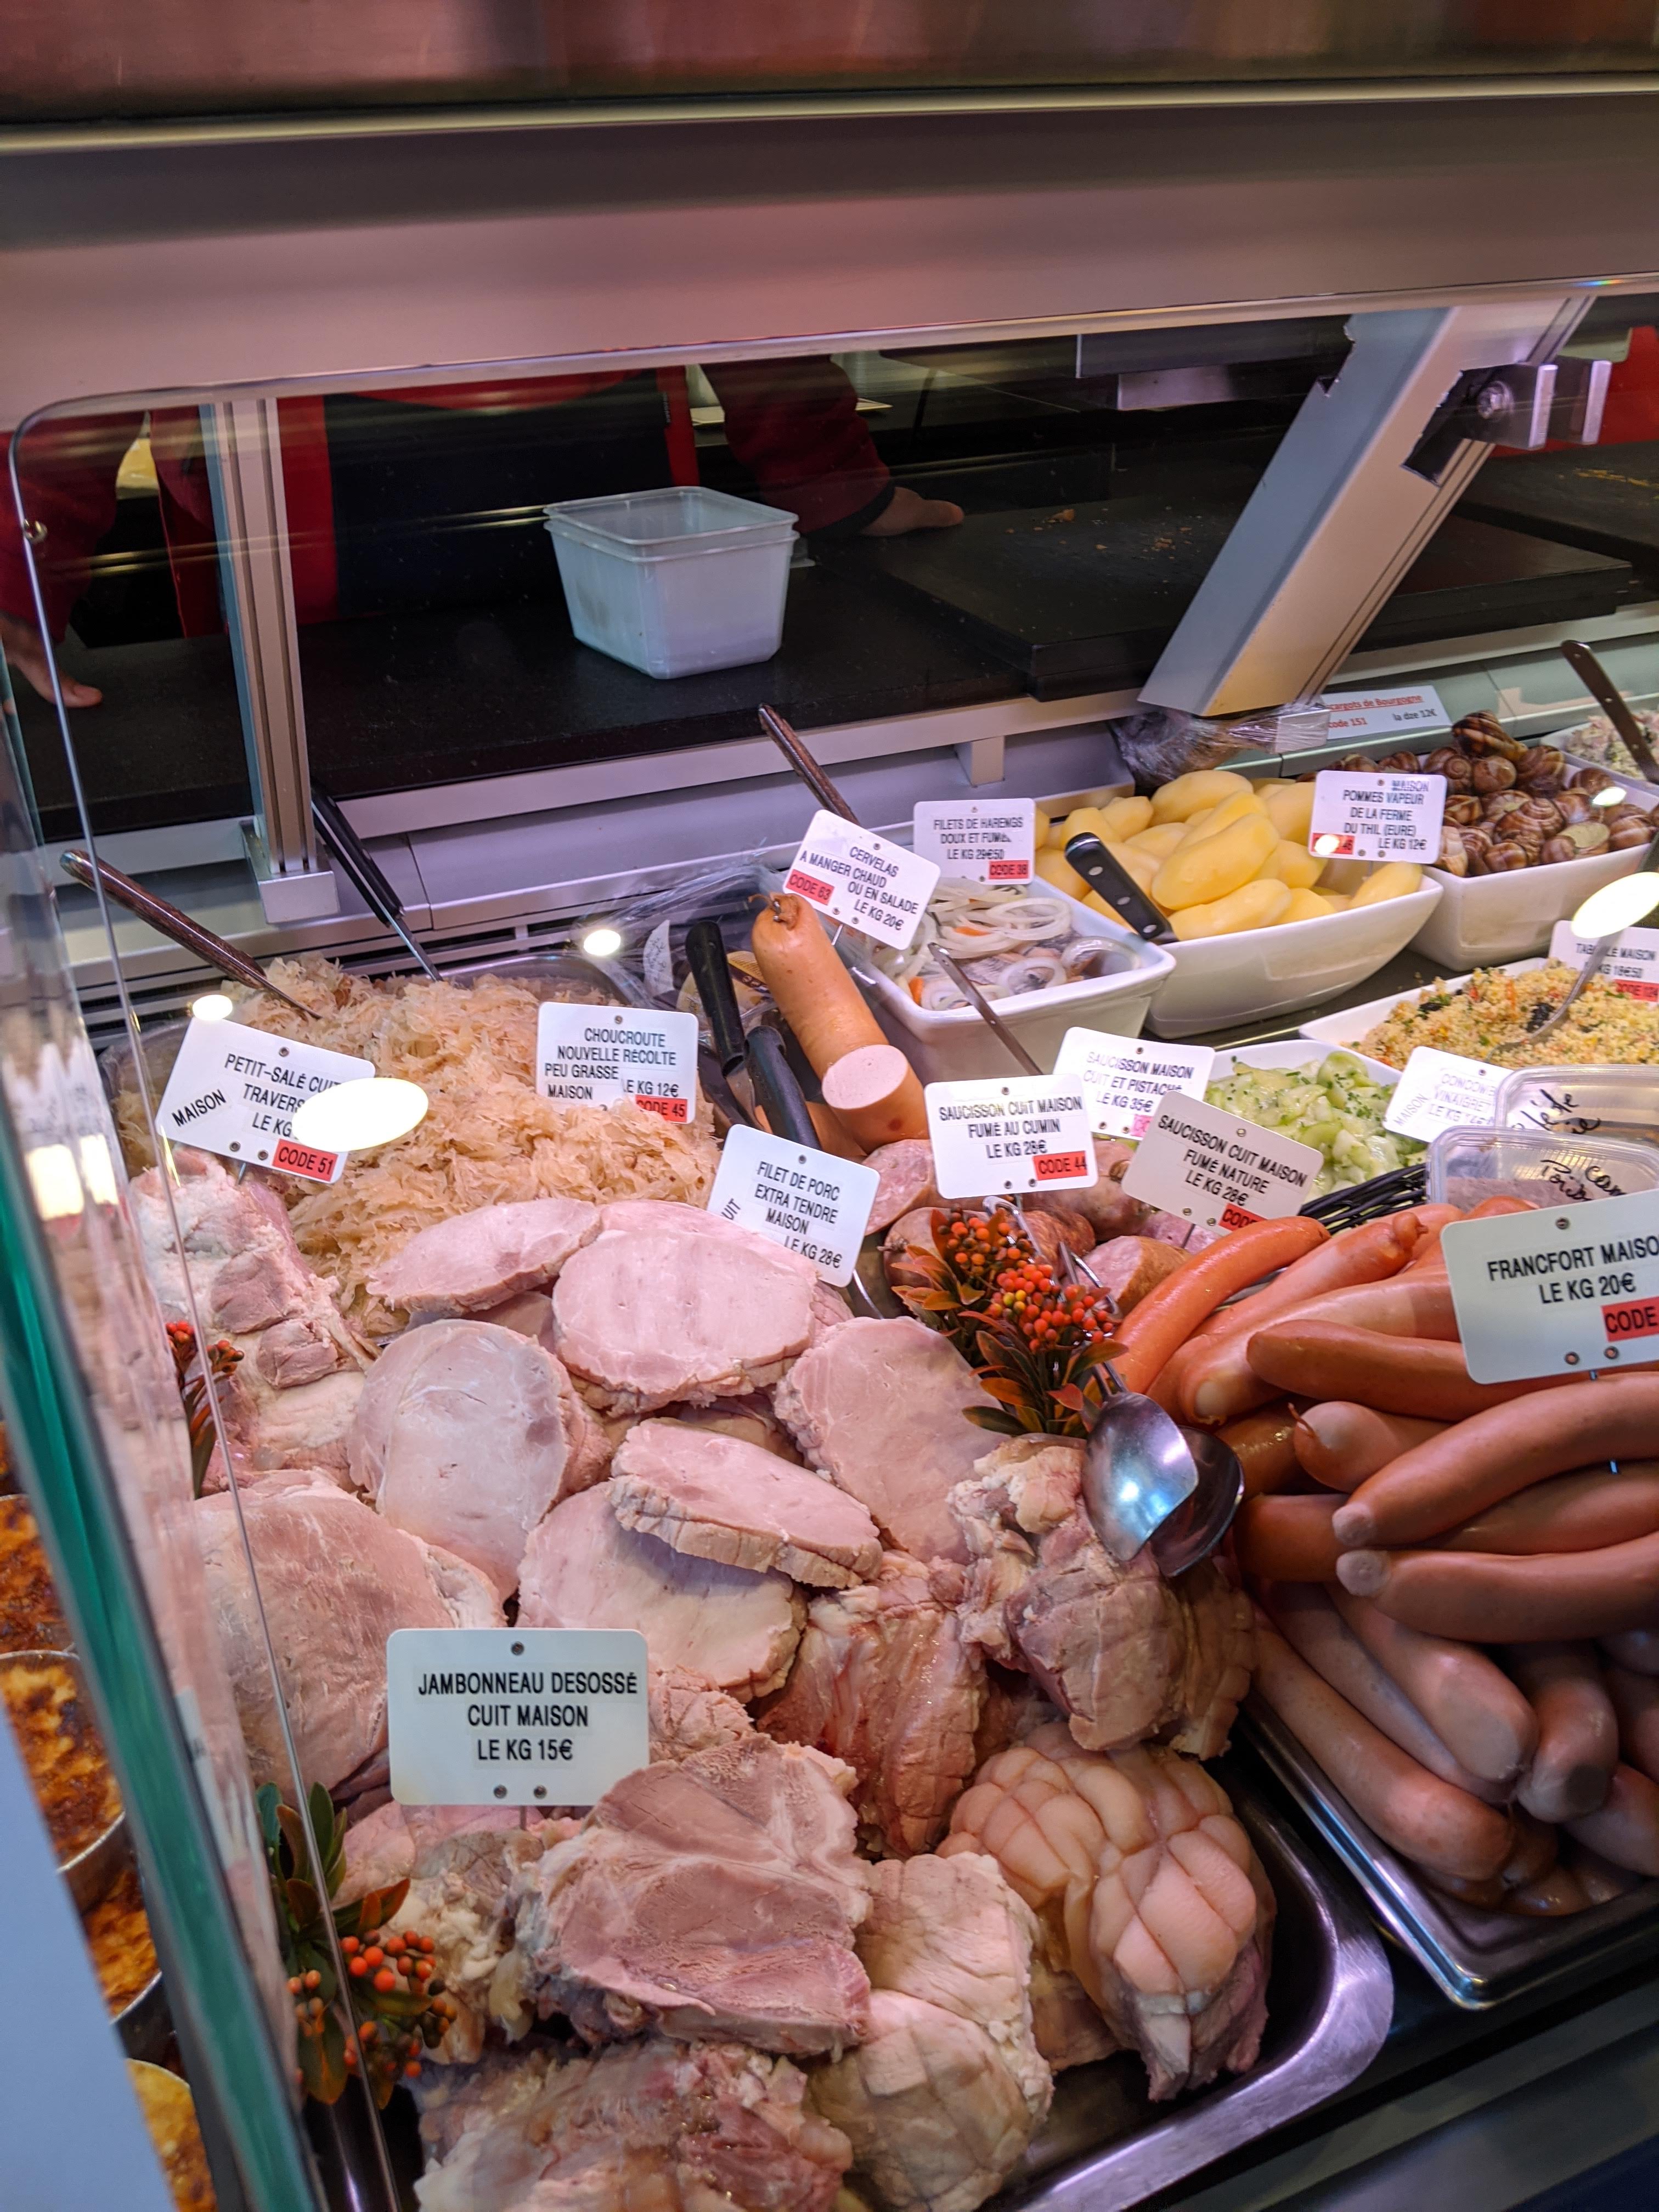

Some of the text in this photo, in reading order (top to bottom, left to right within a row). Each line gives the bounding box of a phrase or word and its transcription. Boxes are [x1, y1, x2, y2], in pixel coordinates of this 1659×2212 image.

[1363, 698, 1374, 707] de
[1375, 695, 1424, 708] Bourgogne
[1328, 716, 1368, 728] code 151
[1342, 789, 1425, 805] POMMES VAPEUR
[1392, 780, 1429, 792] MAISON
[933, 816, 1024, 830] FILETS DE HARENGS
[1350, 806, 1413, 821] DE LA FERME
[940, 833, 967, 844] DOUX
[968, 832, 980, 844] ET
[1344, 822, 1417, 837] DU THIL (EURE)
[947, 849, 960, 860] LE
[961, 849, 974, 860] KG
[1378, 838, 1427, 850] LE KG 12€
[799, 850, 888, 888] A MANGER CHAUD
[849, 846, 900, 878] CERVELAS
[990, 864, 1015, 876] CODE
[789, 874, 833, 901] CODE 63
[847, 881, 919, 915] OU EN SALADE
[854, 899, 905, 932] LE KG 20€
[1620, 947, 1657, 961] MAISON
[584, 1027, 665, 1048] CHOUCROUTE
[557, 1045, 677, 1066] NOUVELLE RÉCOLTE
[1086, 1051, 1194, 1079] SAUCISSON MAISON
[224, 1052, 341, 1093] PETIT-SALÉ CUI
[545, 1062, 619, 1080] PEU GRASSE
[1084, 1069, 1111, 1086] CUIT
[1110, 1076, 1127, 1088] ET
[546, 1084, 594, 1100] MAISON
[637, 1080, 653, 1095] KG
[657, 1082, 679, 1098] 12€
[171, 1088, 227, 1128] MAISON
[672, 1103, 686, 1118] 45
[938, 1096, 1084, 1121] SAUCISSON CUIT MAISON
[1096, 1092, 1154, 1113] LE KG 35€
[1393, 1093, 1429, 1127] MAISON
[251, 1112, 293, 1138] LE KG
[968, 1118, 1062, 1138] FUMÉ AU CUMIN
[278, 1146, 334, 1176] CODE 51
[986, 1143, 1003, 1159] LE
[1005, 1141, 1022, 1157] KG
[1158, 1114, 1309, 1188] SAUCISSON CUIT MAISON
[1038, 1155, 1088, 1175] CODE 44
[1183, 1149, 1271, 1195] FUMÉ NATURE
[756, 1160, 841, 1202] FILET DE PORC
[1184, 1170, 1250, 1207] LE KG 28€
[721, 1198, 741, 1221] UIT
[754, 1183, 839, 1224] EXTRA TENDRE
[765, 1207, 810, 1235] MAISON
[1222, 1208, 1259, 1229] COD
[800, 1242, 818, 1261] KG
[817, 1248, 843, 1269] 28€
[1487, 1234, 1659, 1282] FRANCFORT MAISO
[1538, 1272, 1637, 1305] LE KG 20€
[1605, 1306, 1658, 1334] CODE
[418, 1671, 638, 1696] JAMBONNEAU DESOSSÉ
[467, 1704, 589, 1727] CUIT MAISON
[477, 1739, 574, 1761] LE KG 15€
